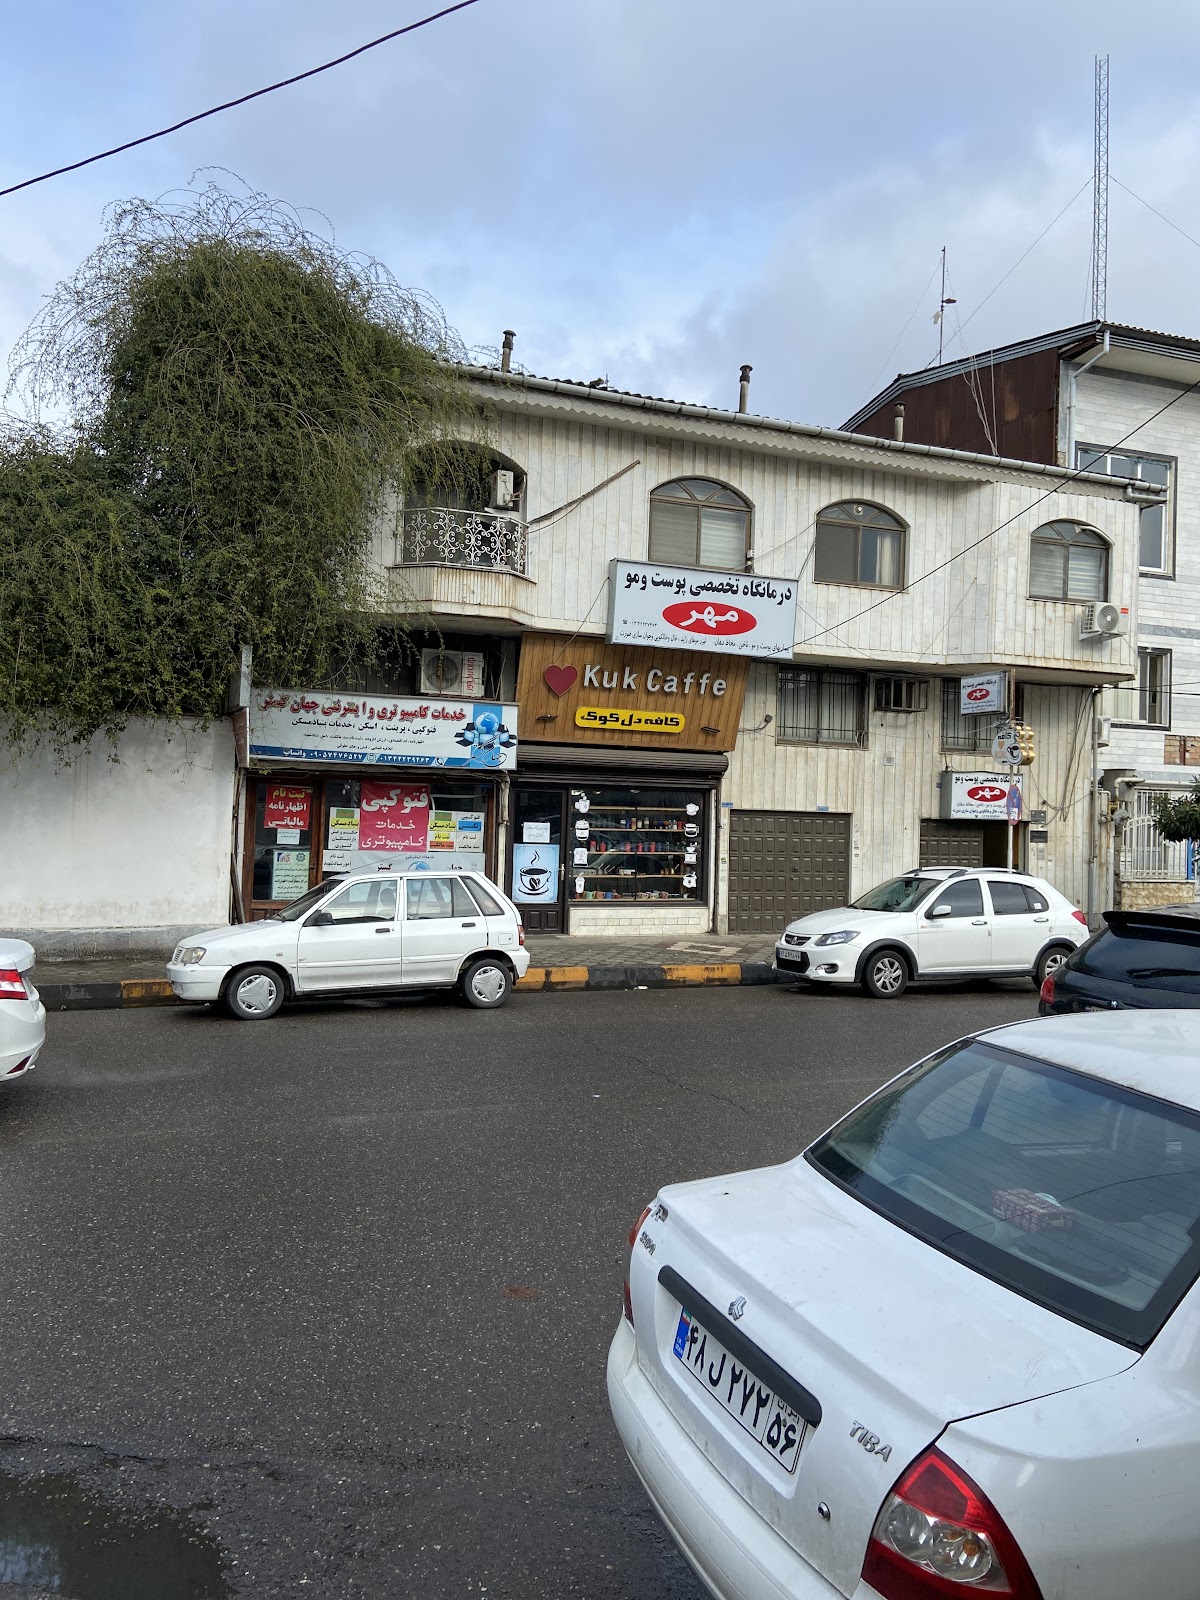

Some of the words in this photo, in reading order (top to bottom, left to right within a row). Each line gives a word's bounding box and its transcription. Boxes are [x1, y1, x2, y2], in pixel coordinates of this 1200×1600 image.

[651, 572, 686, 596] پوست
[689, 577, 740, 597] تخصصی
[743, 579, 792, 606] درمانگاه
[679, 606, 739, 629] مهر
[583, 663, 639, 690] Kuk
[646, 668, 728, 696] Caffe
[970, 689, 987, 700] مهر
[289, 695, 320, 715] جهان
[431, 706, 467, 721] خدمات
[580, 711, 621, 725] کوک
[620, 713, 642, 727] دل
[358, 721, 378, 731] اسکن
[644, 714, 680, 727] کافه
[385, 723, 406, 734] پرینت
[283, 748, 306, 759] واتساپ
[964, 775, 979, 785] پوست
[272, 787, 286, 800] نام
[288, 788, 306, 799] ثبت
[973, 787, 1001, 800] مهر
[268, 801, 307, 813] اظهارنامه
[267, 816, 305, 828] مالیاتی
[375, 818, 416, 830] خدمات
[361, 835, 426, 851] کامپیوتری
[766, 1411, 798, 1456] ۵۶
[849, 1419, 894, 1463] TIBA
